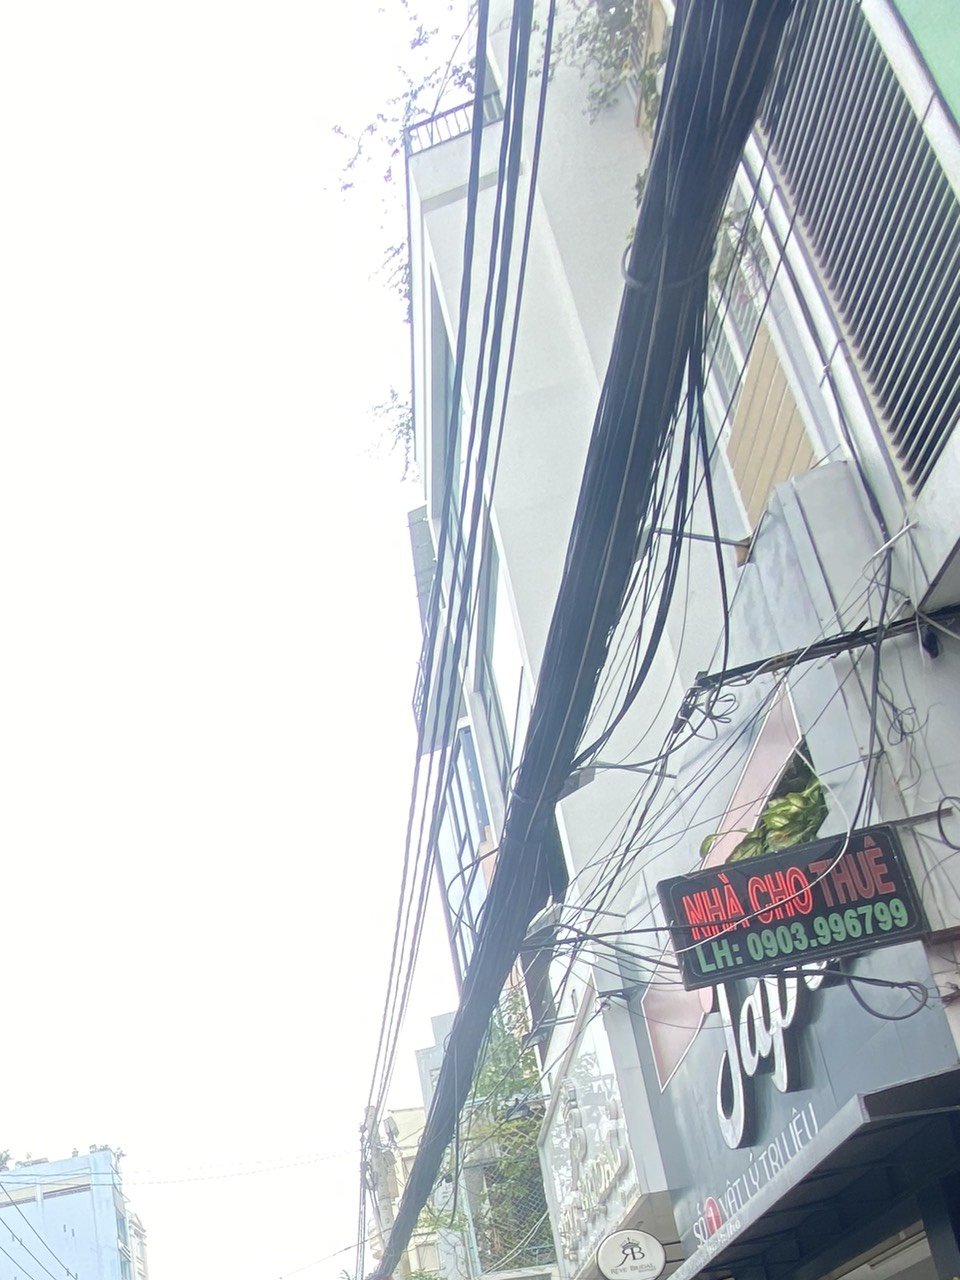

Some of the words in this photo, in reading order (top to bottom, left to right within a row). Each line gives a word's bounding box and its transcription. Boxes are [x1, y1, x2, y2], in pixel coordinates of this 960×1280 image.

[682, 872, 749, 941] NHÀ
[748, 866, 813, 924] CHO
[808, 835, 896, 908] THUÊ
[695, 939, 743, 973] LH:
[747, 898, 909, 962] 0903.996799
[716, 960, 835, 1150] Jap
